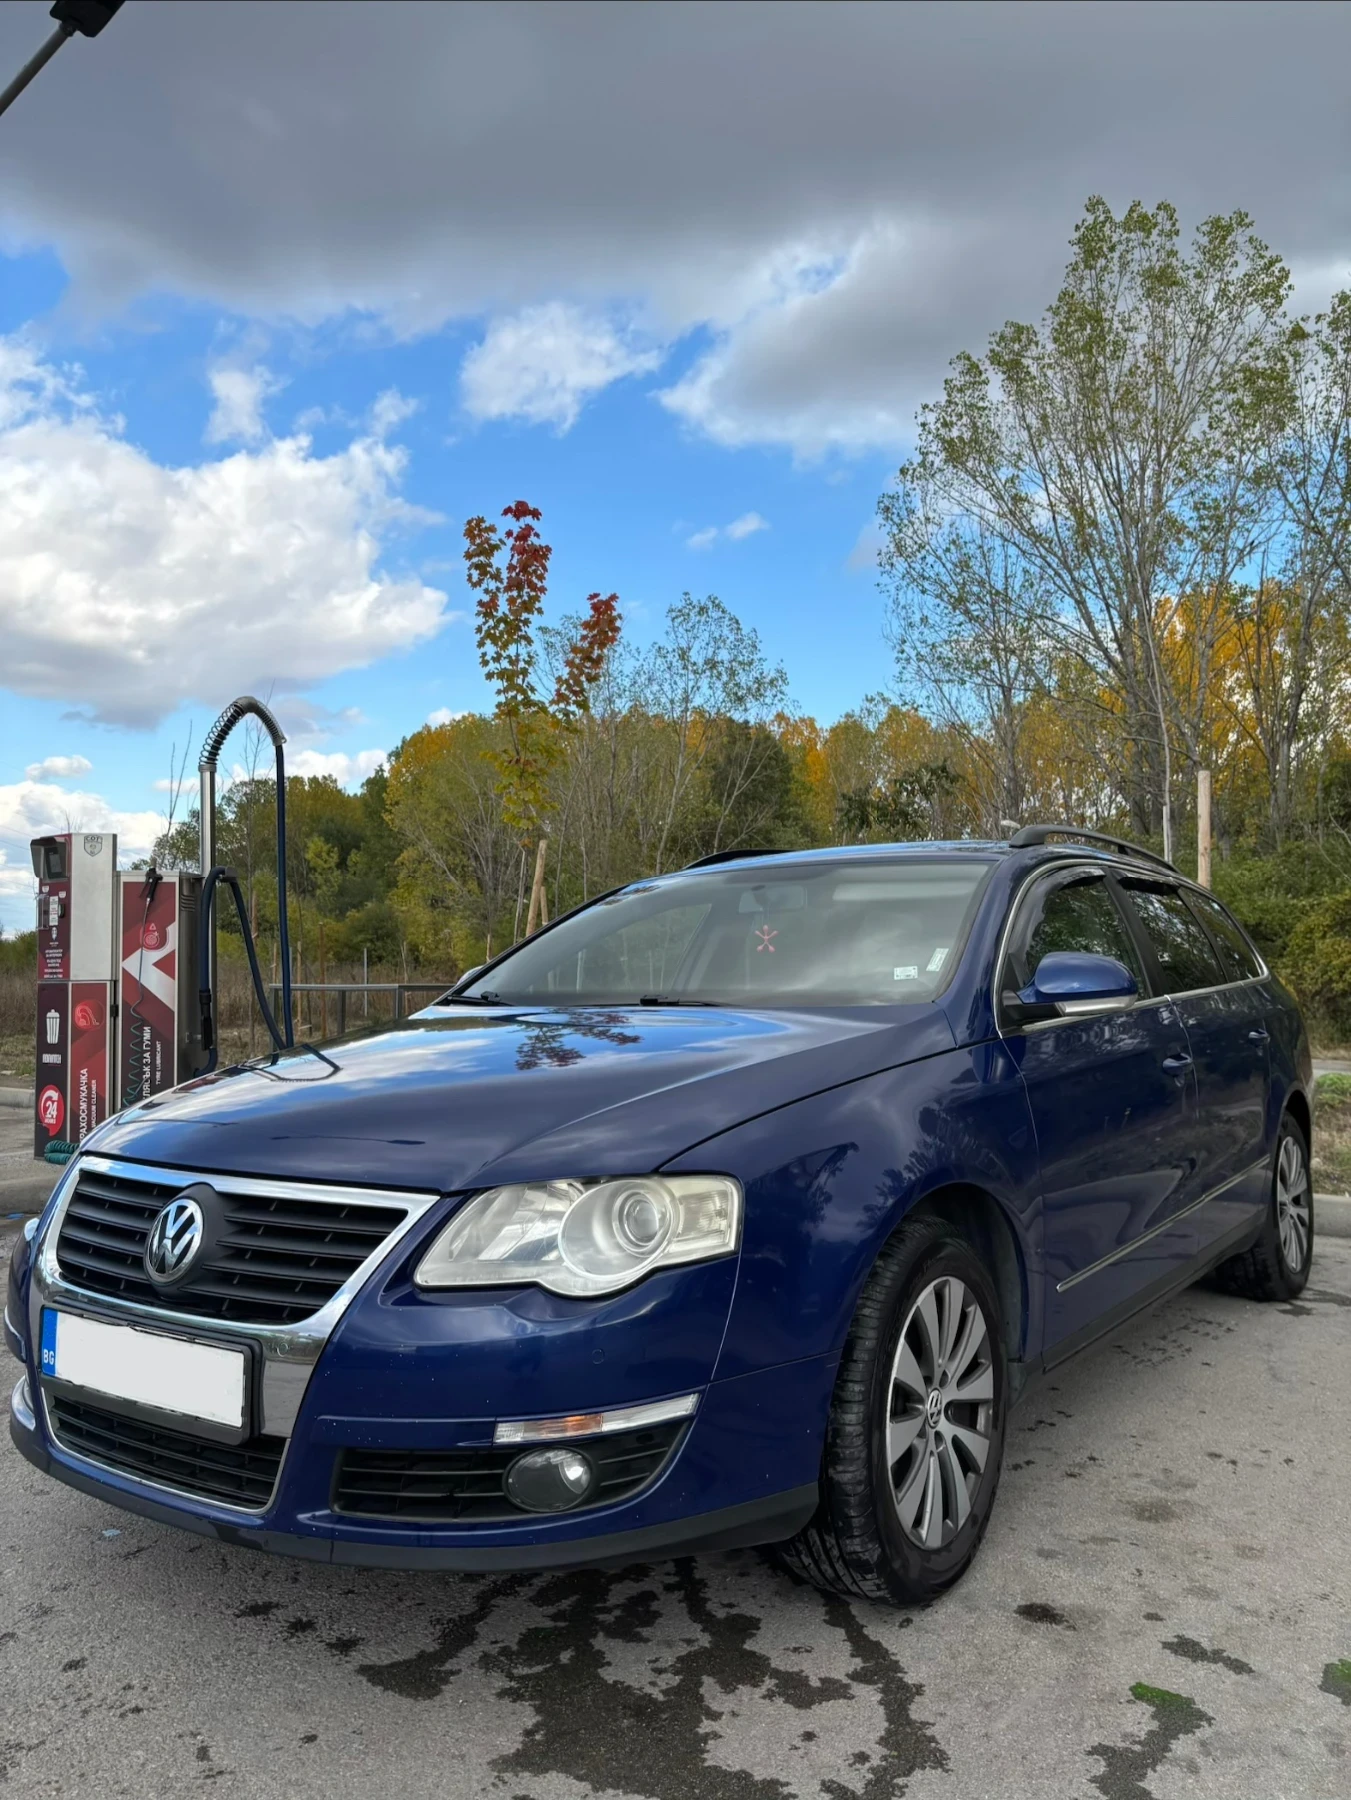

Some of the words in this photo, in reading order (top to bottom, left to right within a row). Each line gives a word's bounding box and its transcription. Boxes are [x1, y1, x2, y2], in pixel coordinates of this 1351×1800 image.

[143, 1026, 151, 1050] ГУМИ
[143, 1051, 151, 1064] ЗА
[46, 1100, 58, 1118] 24
[43, 1348, 55, 1365] BG
